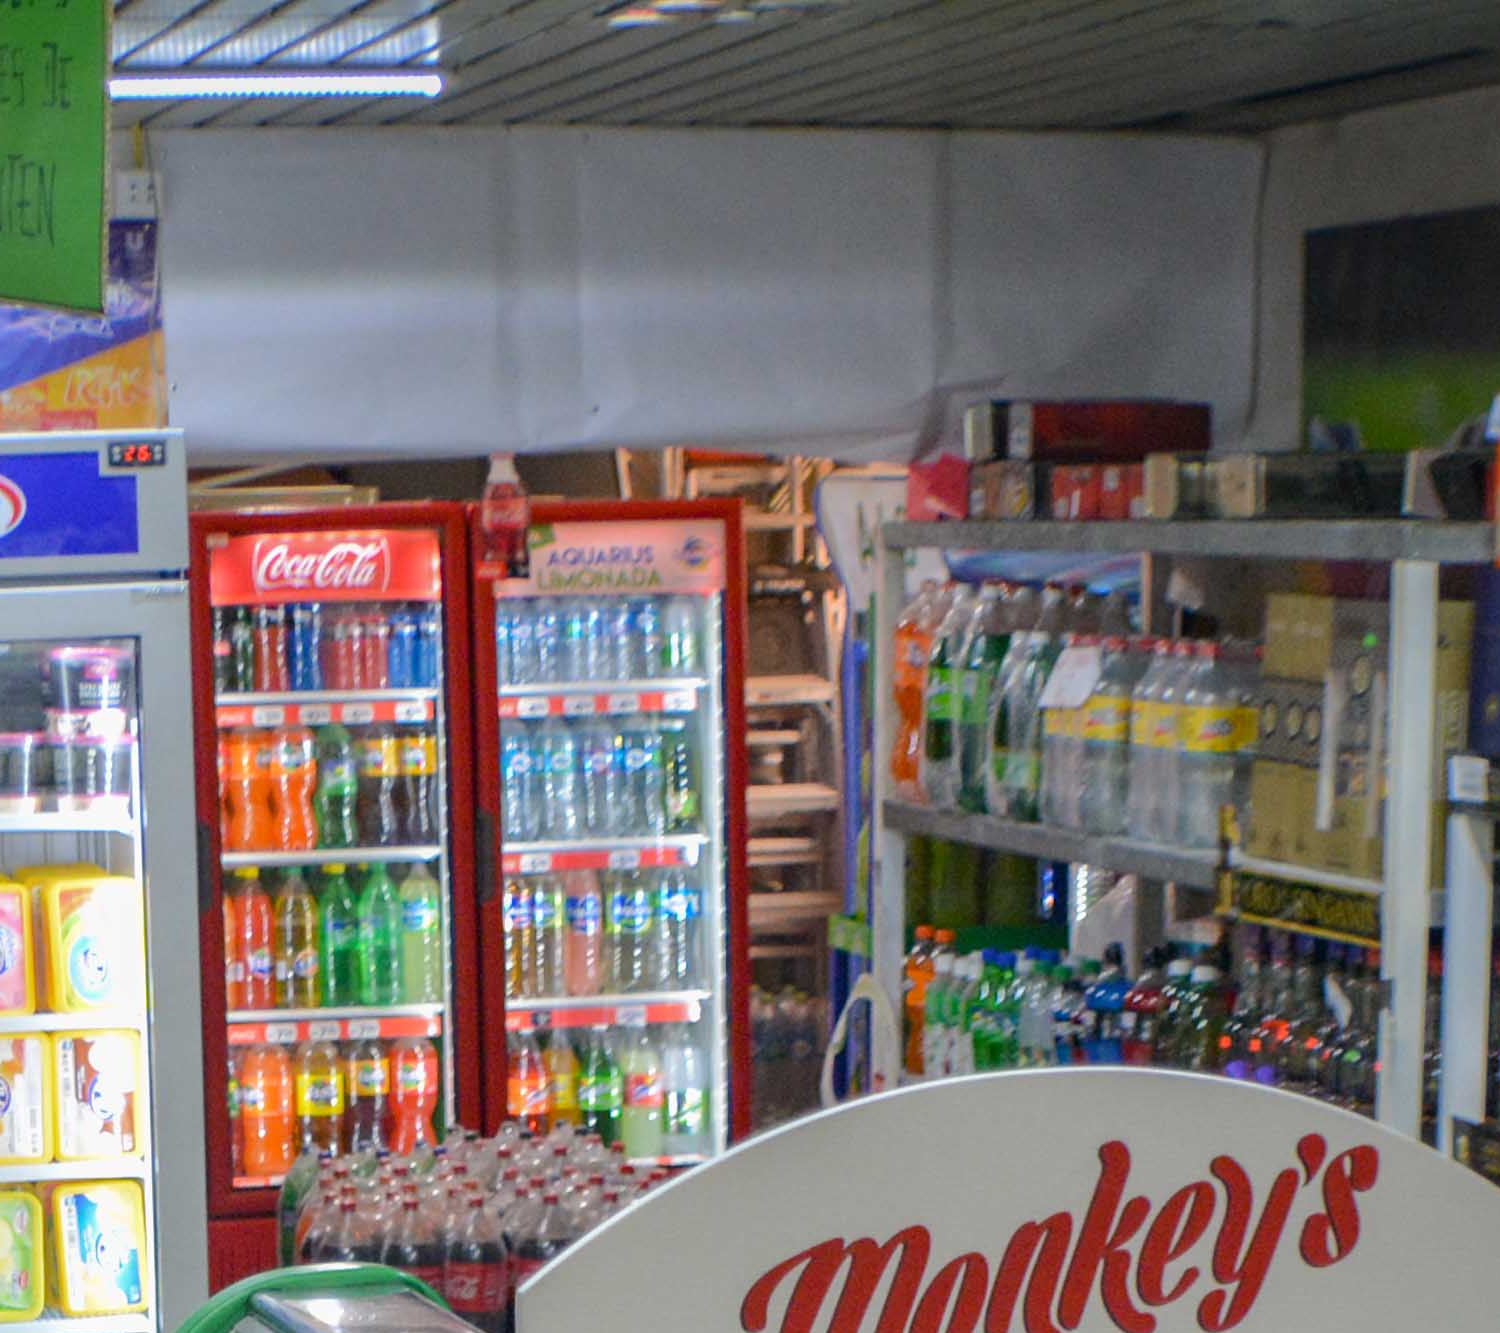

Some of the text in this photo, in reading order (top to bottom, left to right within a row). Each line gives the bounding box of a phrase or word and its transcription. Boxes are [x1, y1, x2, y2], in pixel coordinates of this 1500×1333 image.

[253, 539, 384, 591] Coca-Cola
[547, 545, 655, 569] AQUARIUS
[536, 567, 661, 591] LIMONADA
